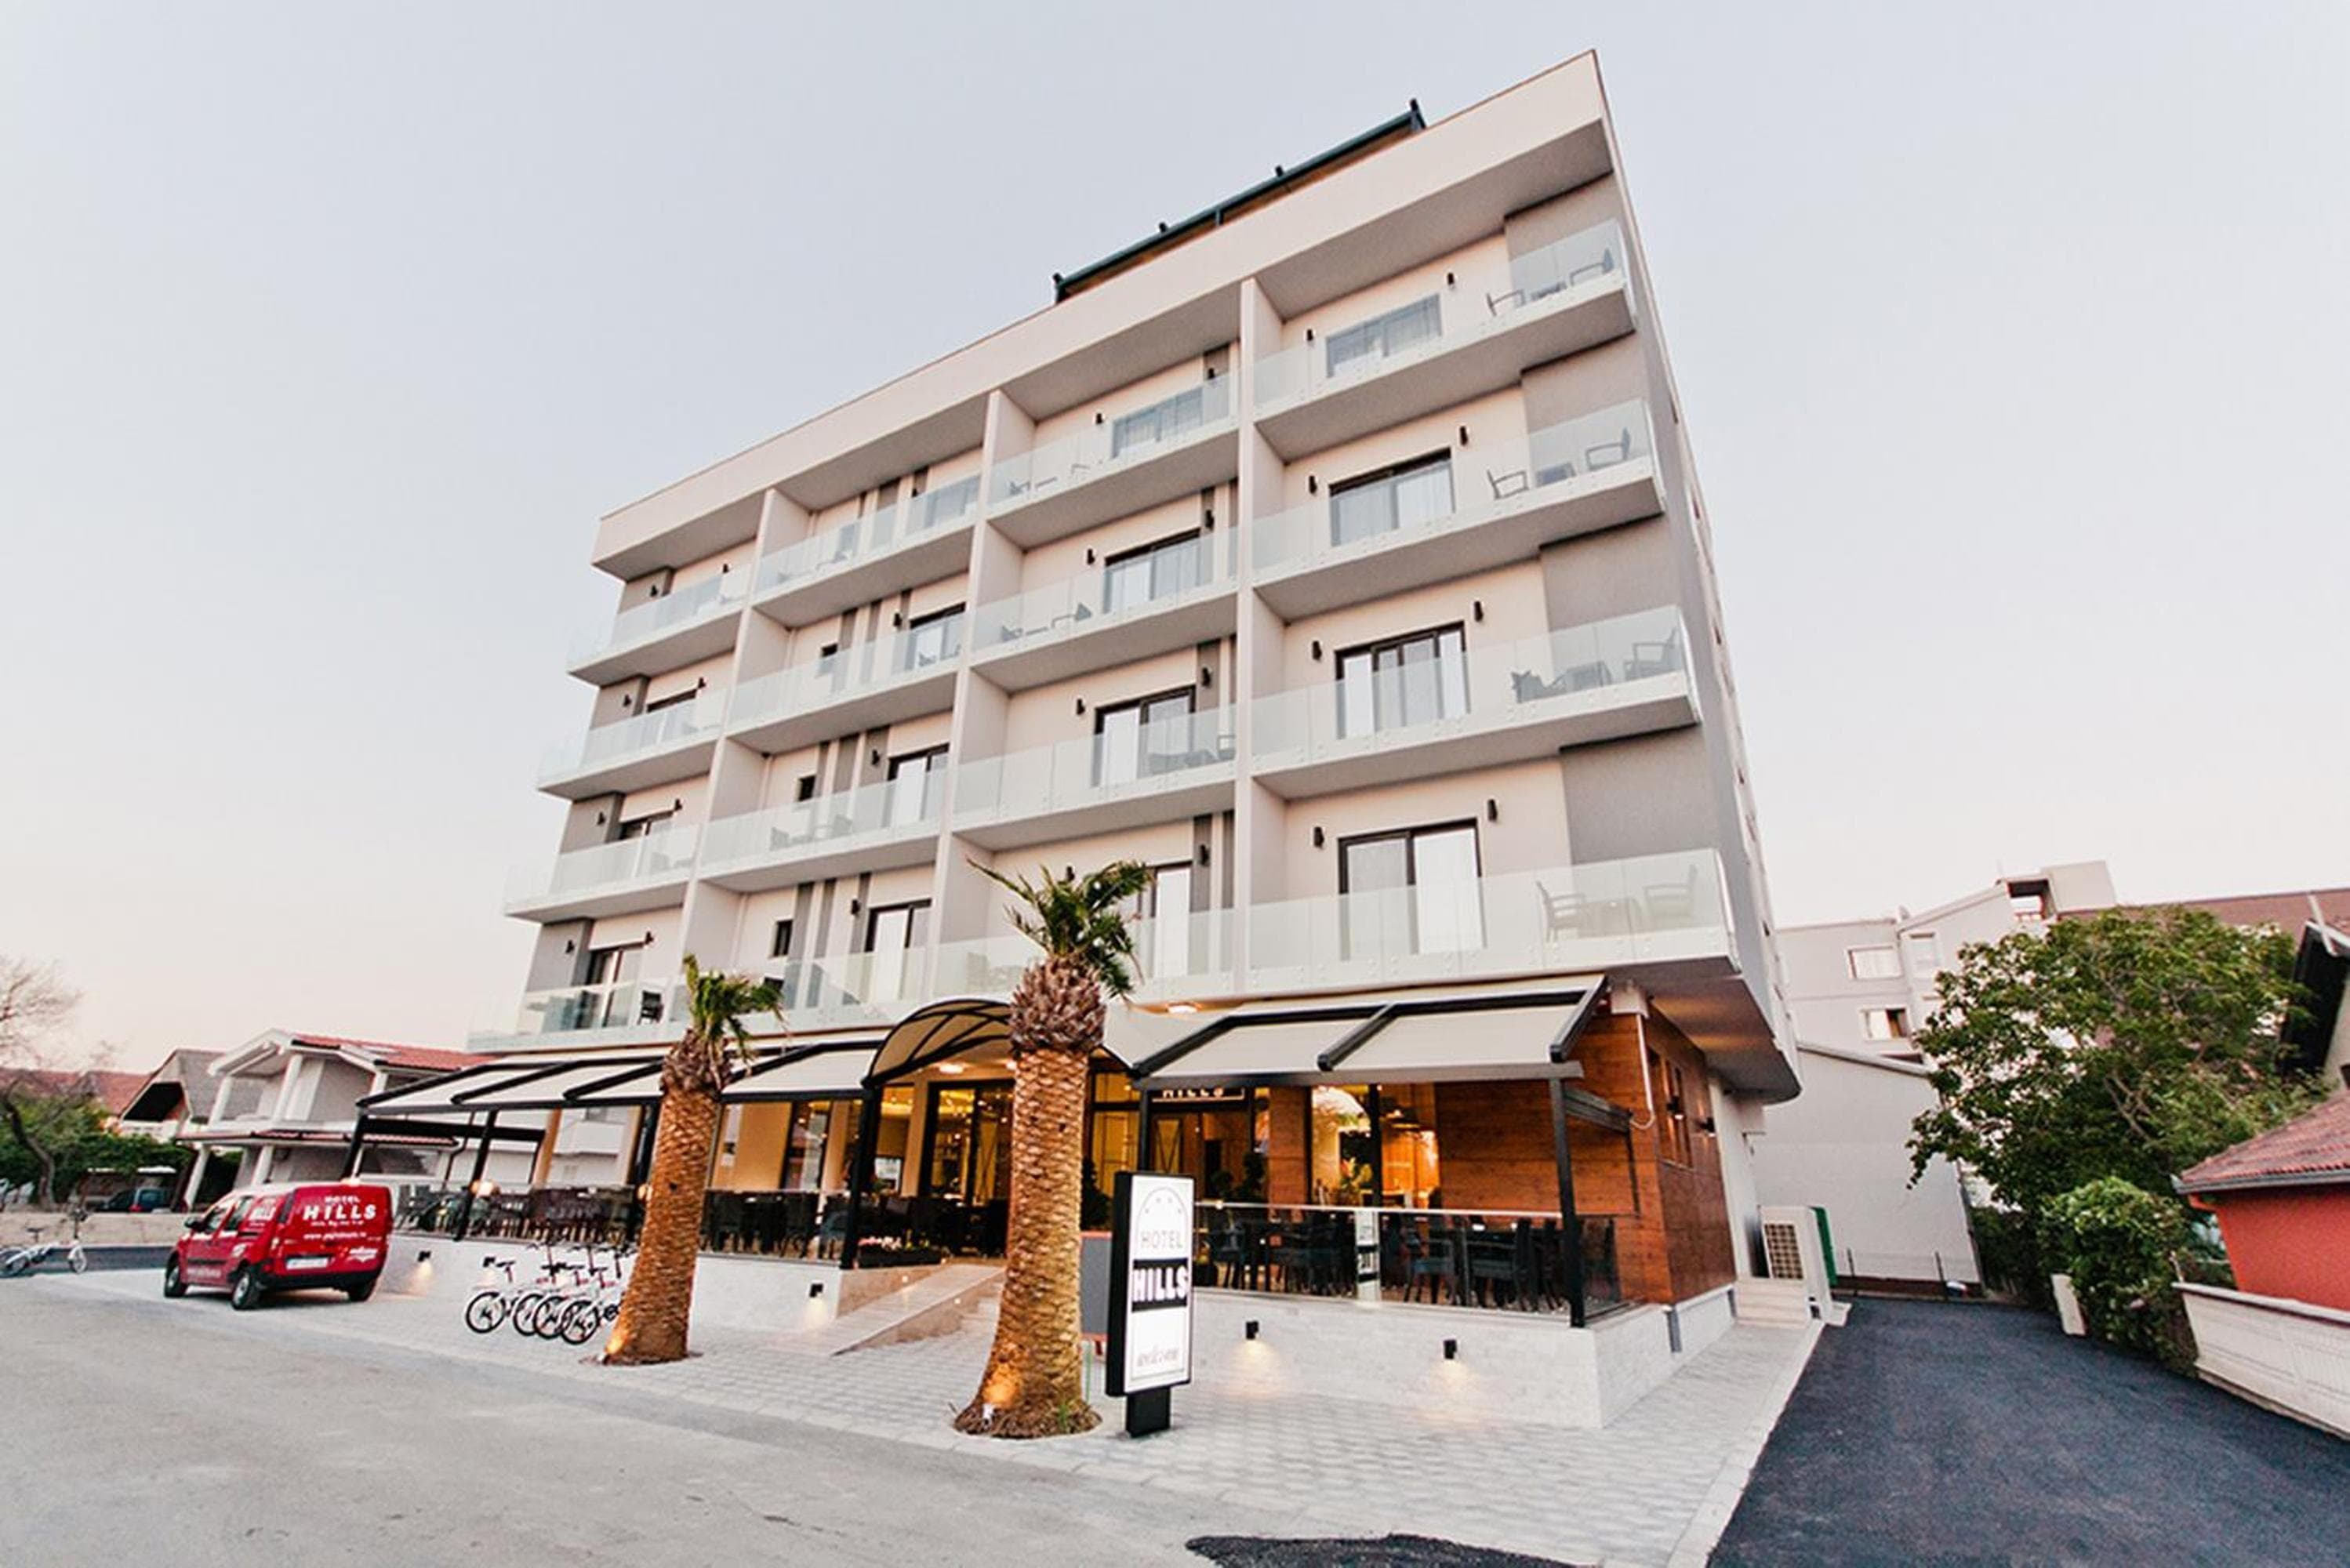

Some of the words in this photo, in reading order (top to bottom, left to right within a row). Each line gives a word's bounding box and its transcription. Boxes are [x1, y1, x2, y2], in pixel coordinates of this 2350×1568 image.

[303, 1204, 376, 1220] HILLS
[1140, 1229, 1183, 1249] HOTEL
[1132, 1265, 1189, 1303] HILLS
